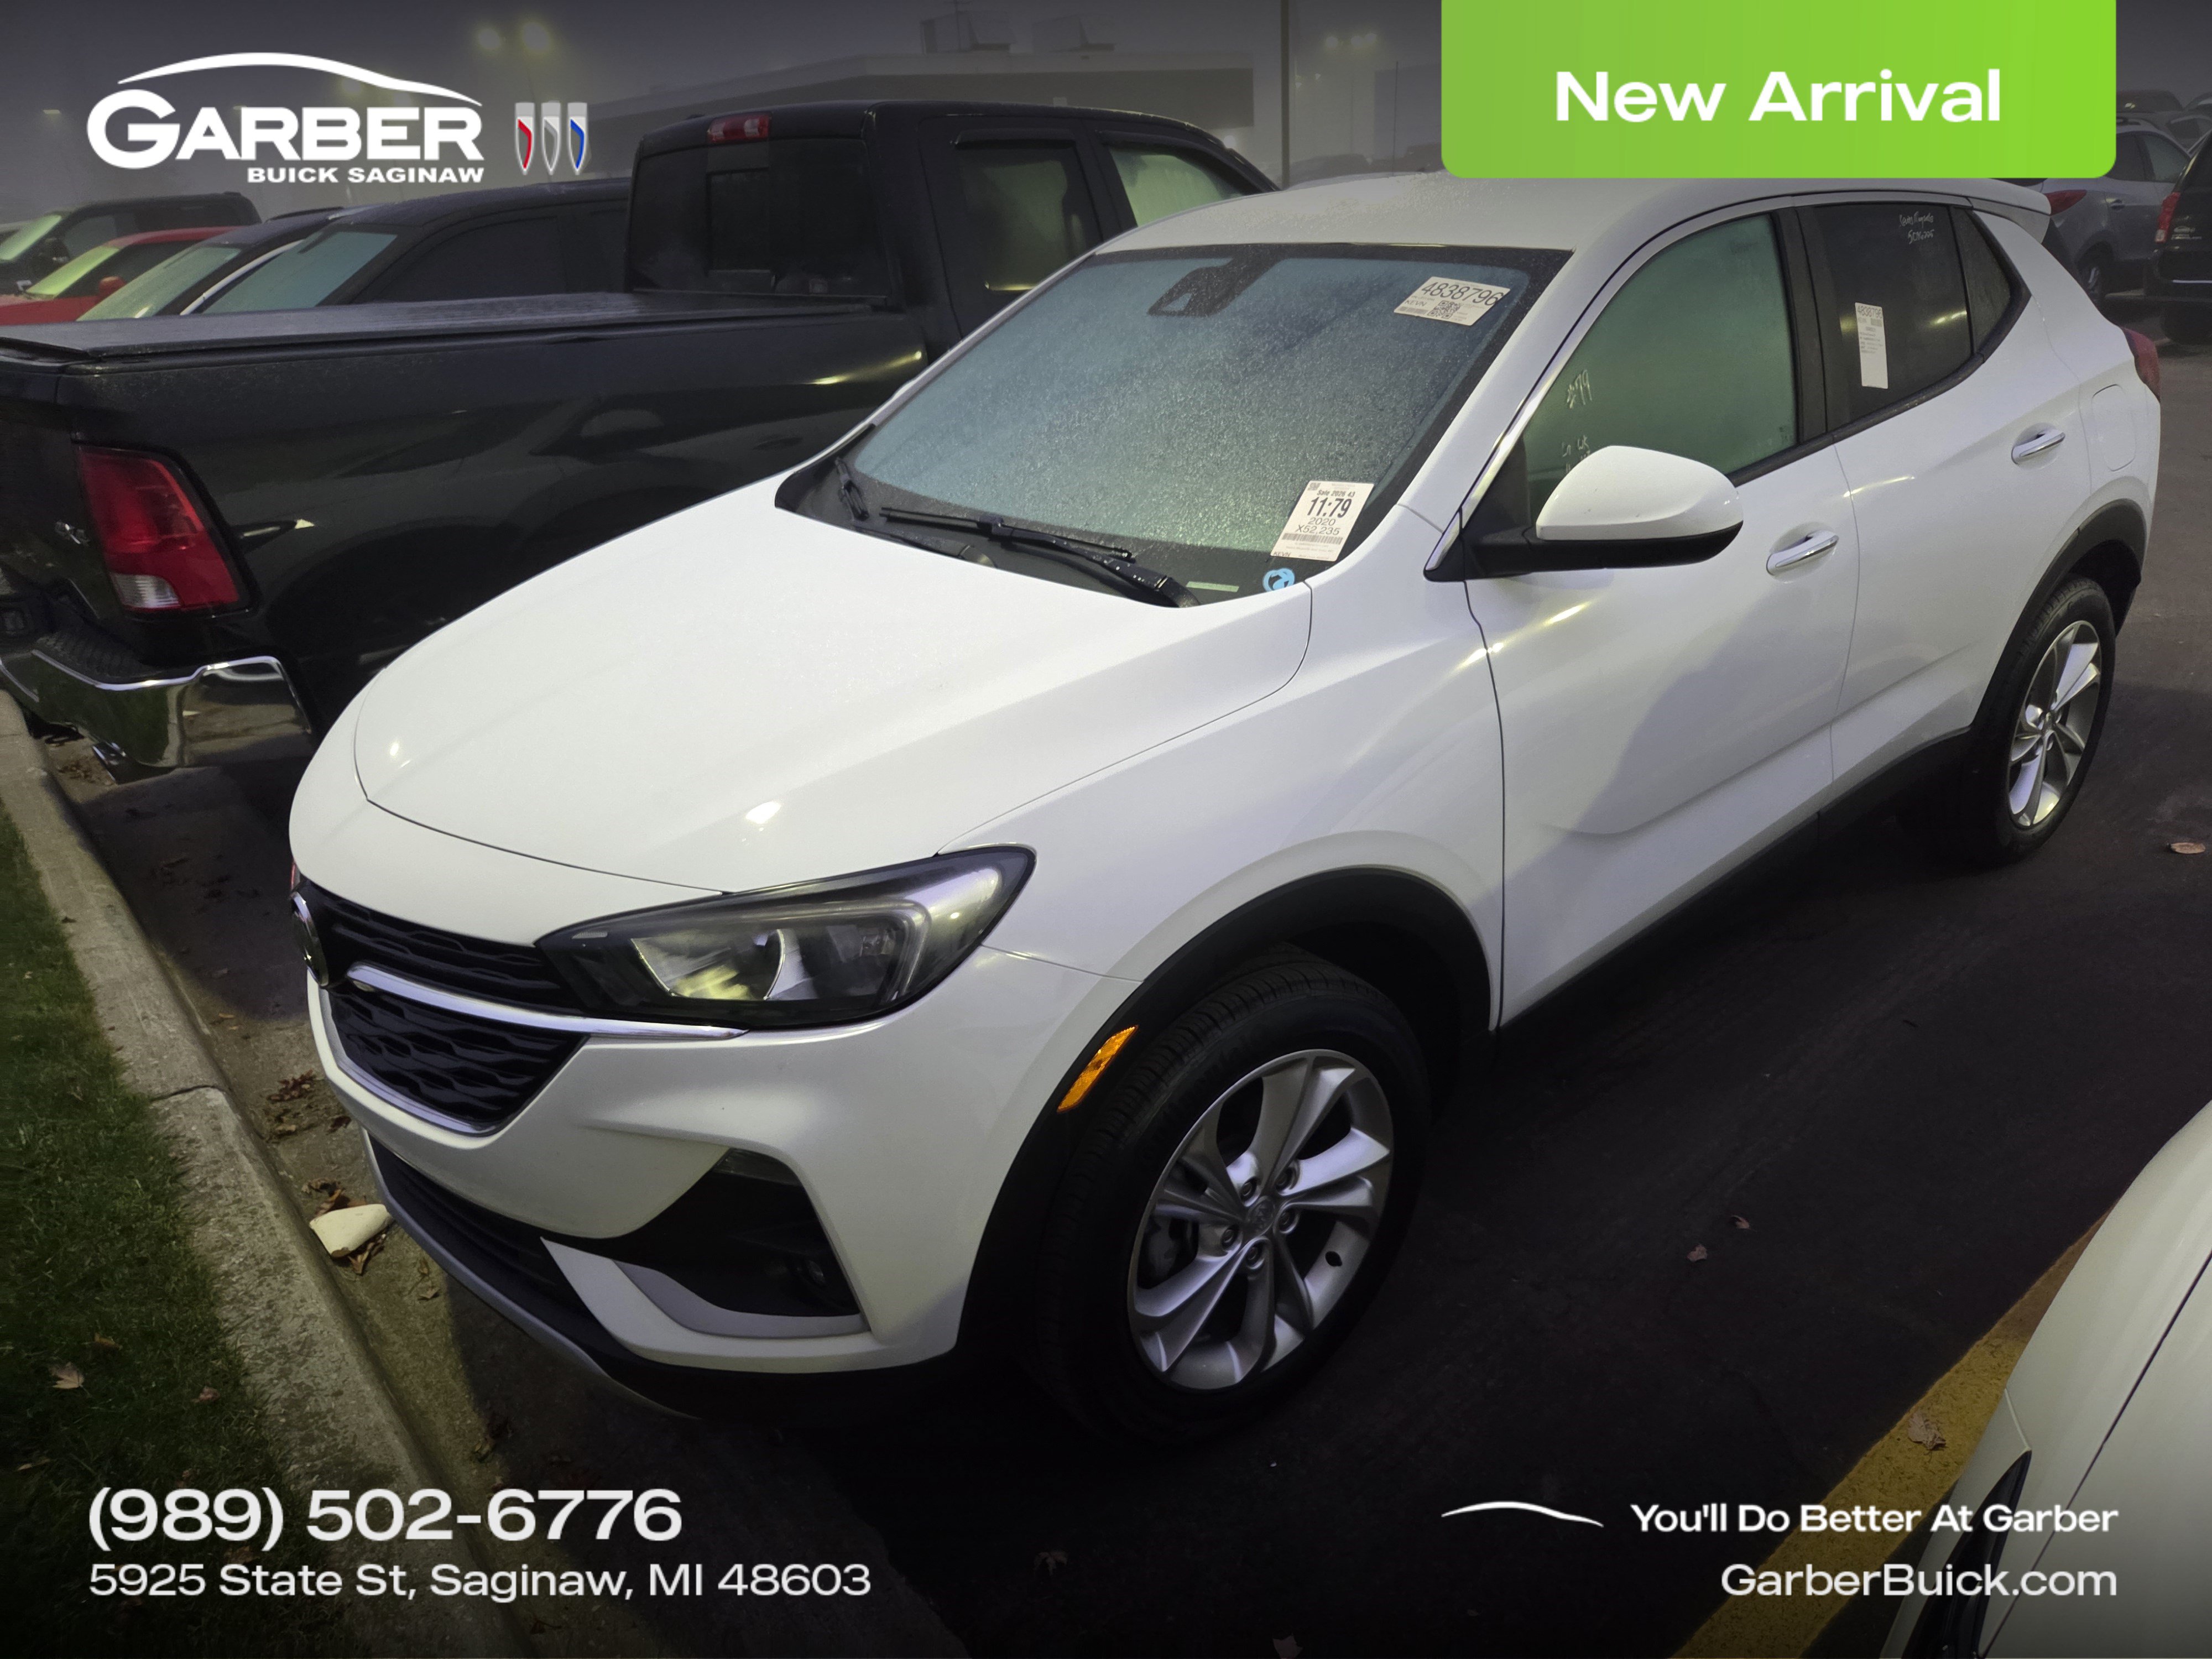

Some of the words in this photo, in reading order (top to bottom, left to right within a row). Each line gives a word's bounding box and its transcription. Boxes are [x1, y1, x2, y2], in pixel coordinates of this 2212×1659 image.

[1421, 281, 1504, 306] 4838796
[1307, 497, 1352, 518] 11:79
[1308, 517, 1336, 526] 2020
